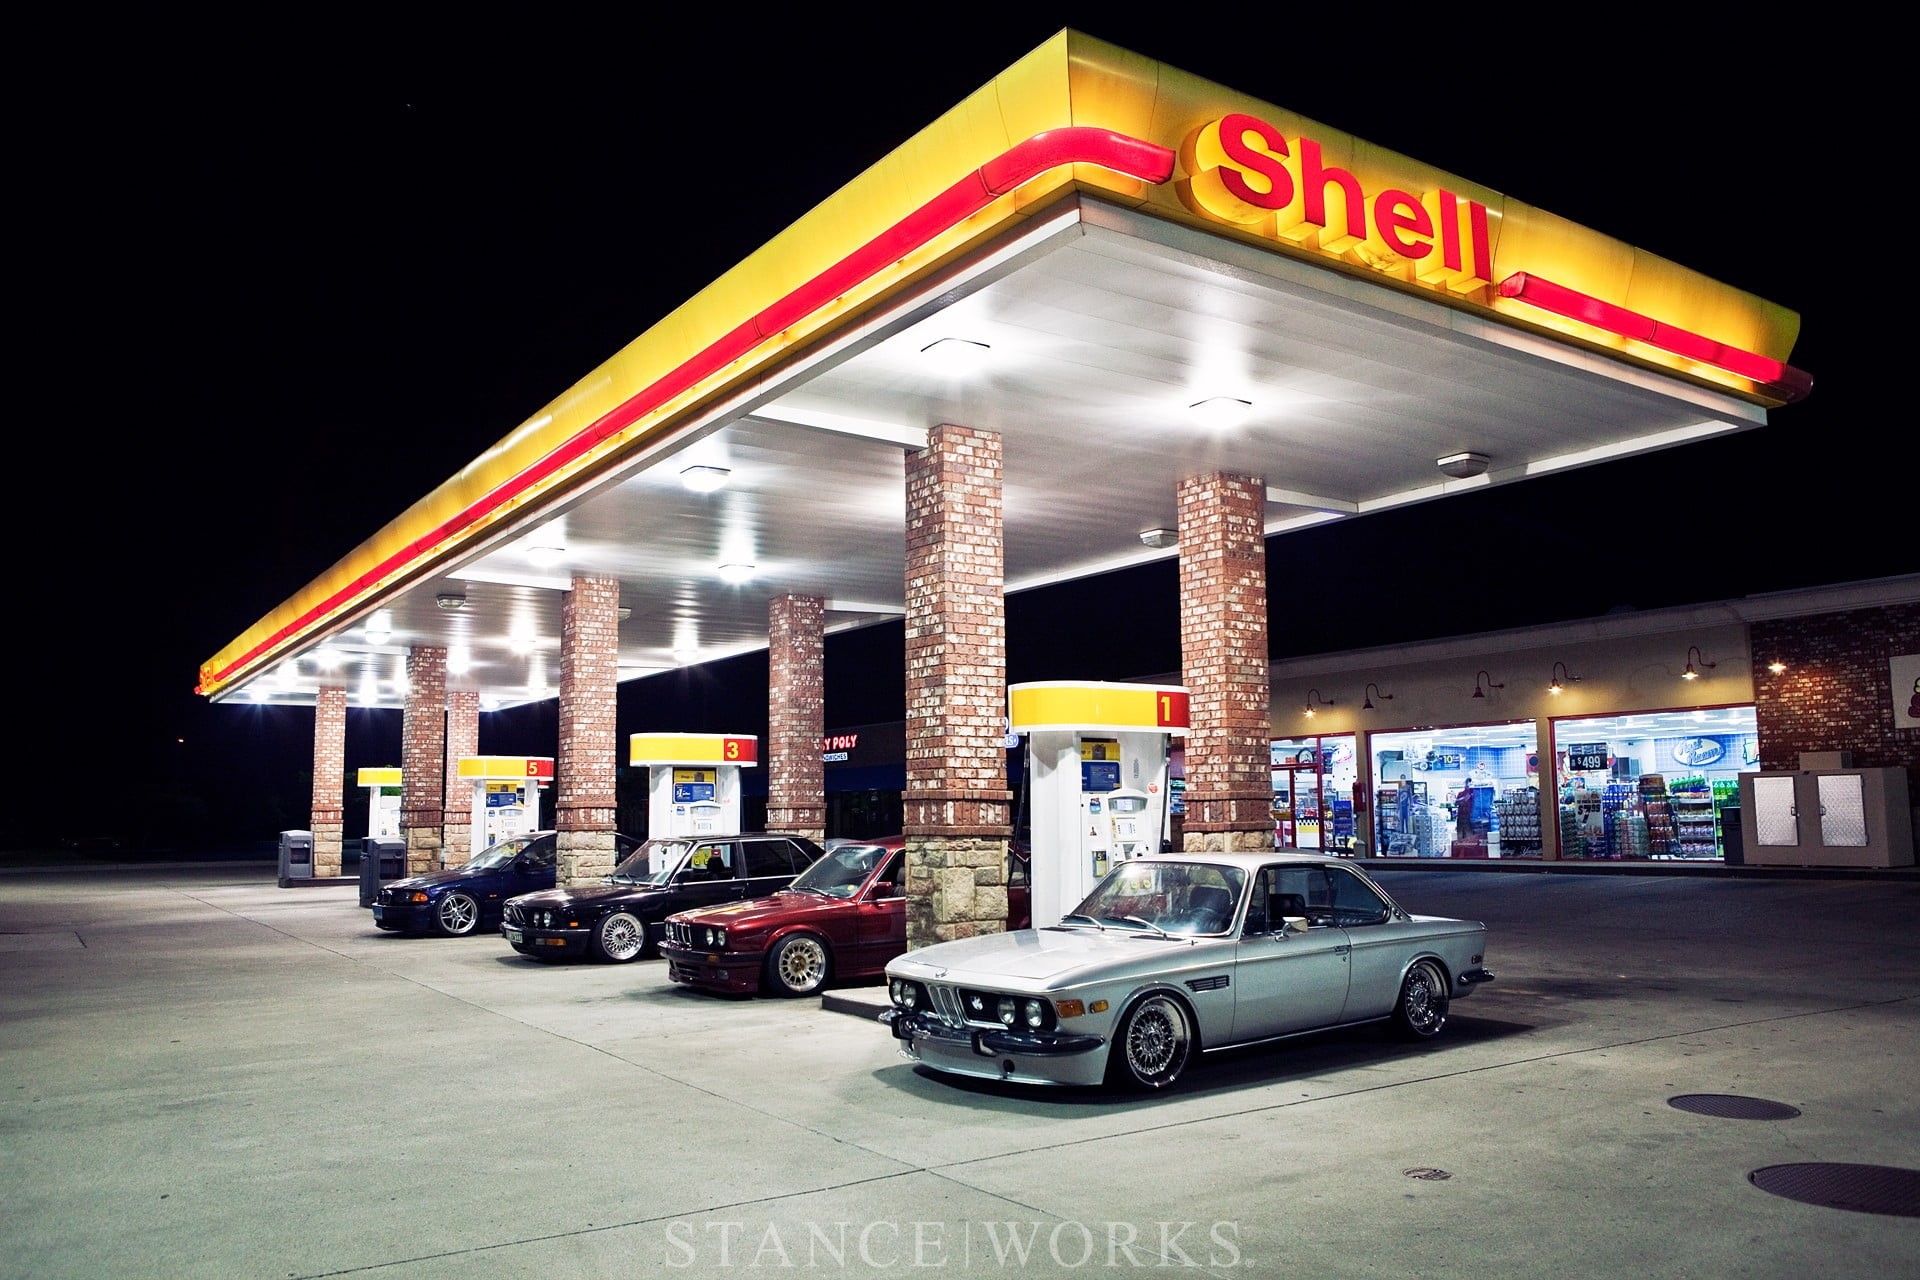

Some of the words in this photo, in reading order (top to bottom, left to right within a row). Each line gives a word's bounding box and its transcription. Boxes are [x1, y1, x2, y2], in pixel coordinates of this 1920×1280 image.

[1217, 112, 1492, 283] Shell
[1161, 696, 1171, 722] 1
[726, 742, 739, 759] 3
[832, 734, 858, 750] POLY
[528, 762, 538, 775] 5
